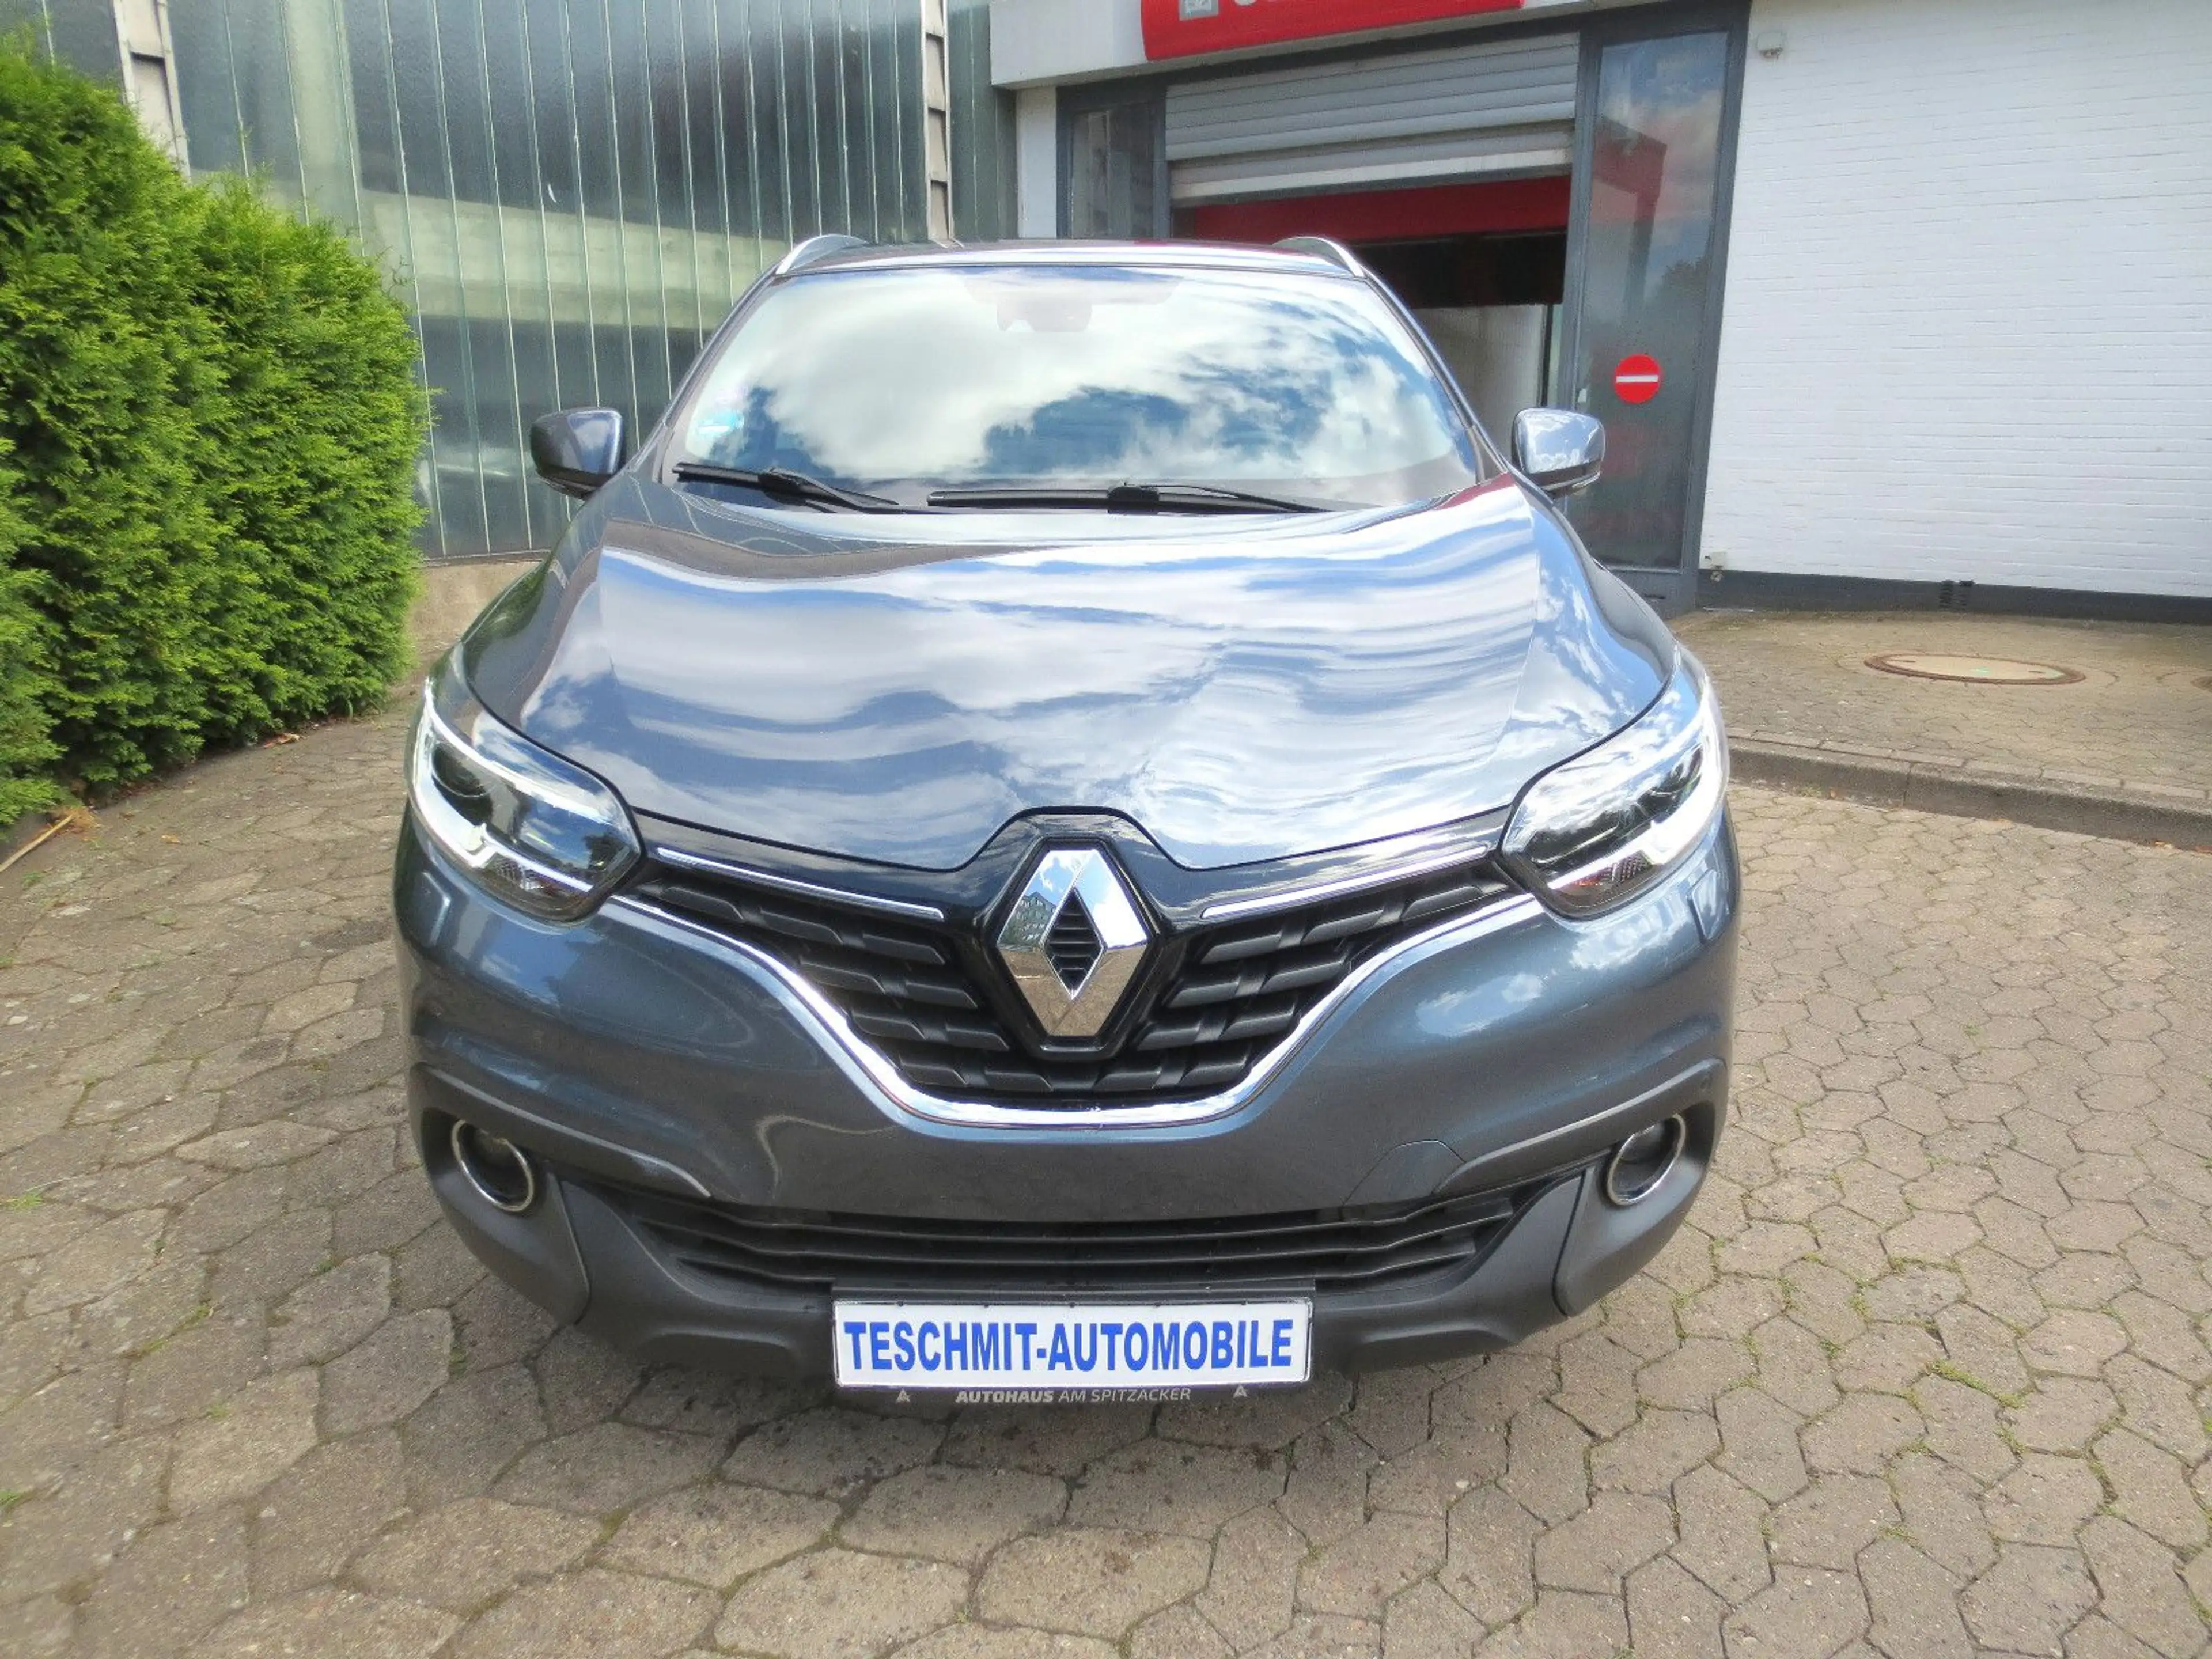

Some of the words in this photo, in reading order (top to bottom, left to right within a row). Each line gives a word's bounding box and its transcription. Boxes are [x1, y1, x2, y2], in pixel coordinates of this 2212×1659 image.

[844, 1320, 1293, 1371] TESCHMIT-AUTOMOBILE
[955, 1390, 1053, 1403] AUTOHAUS
[1059, 1389, 1087, 1402] AM
[1091, 1388, 1191, 1401] SPITZACKER
